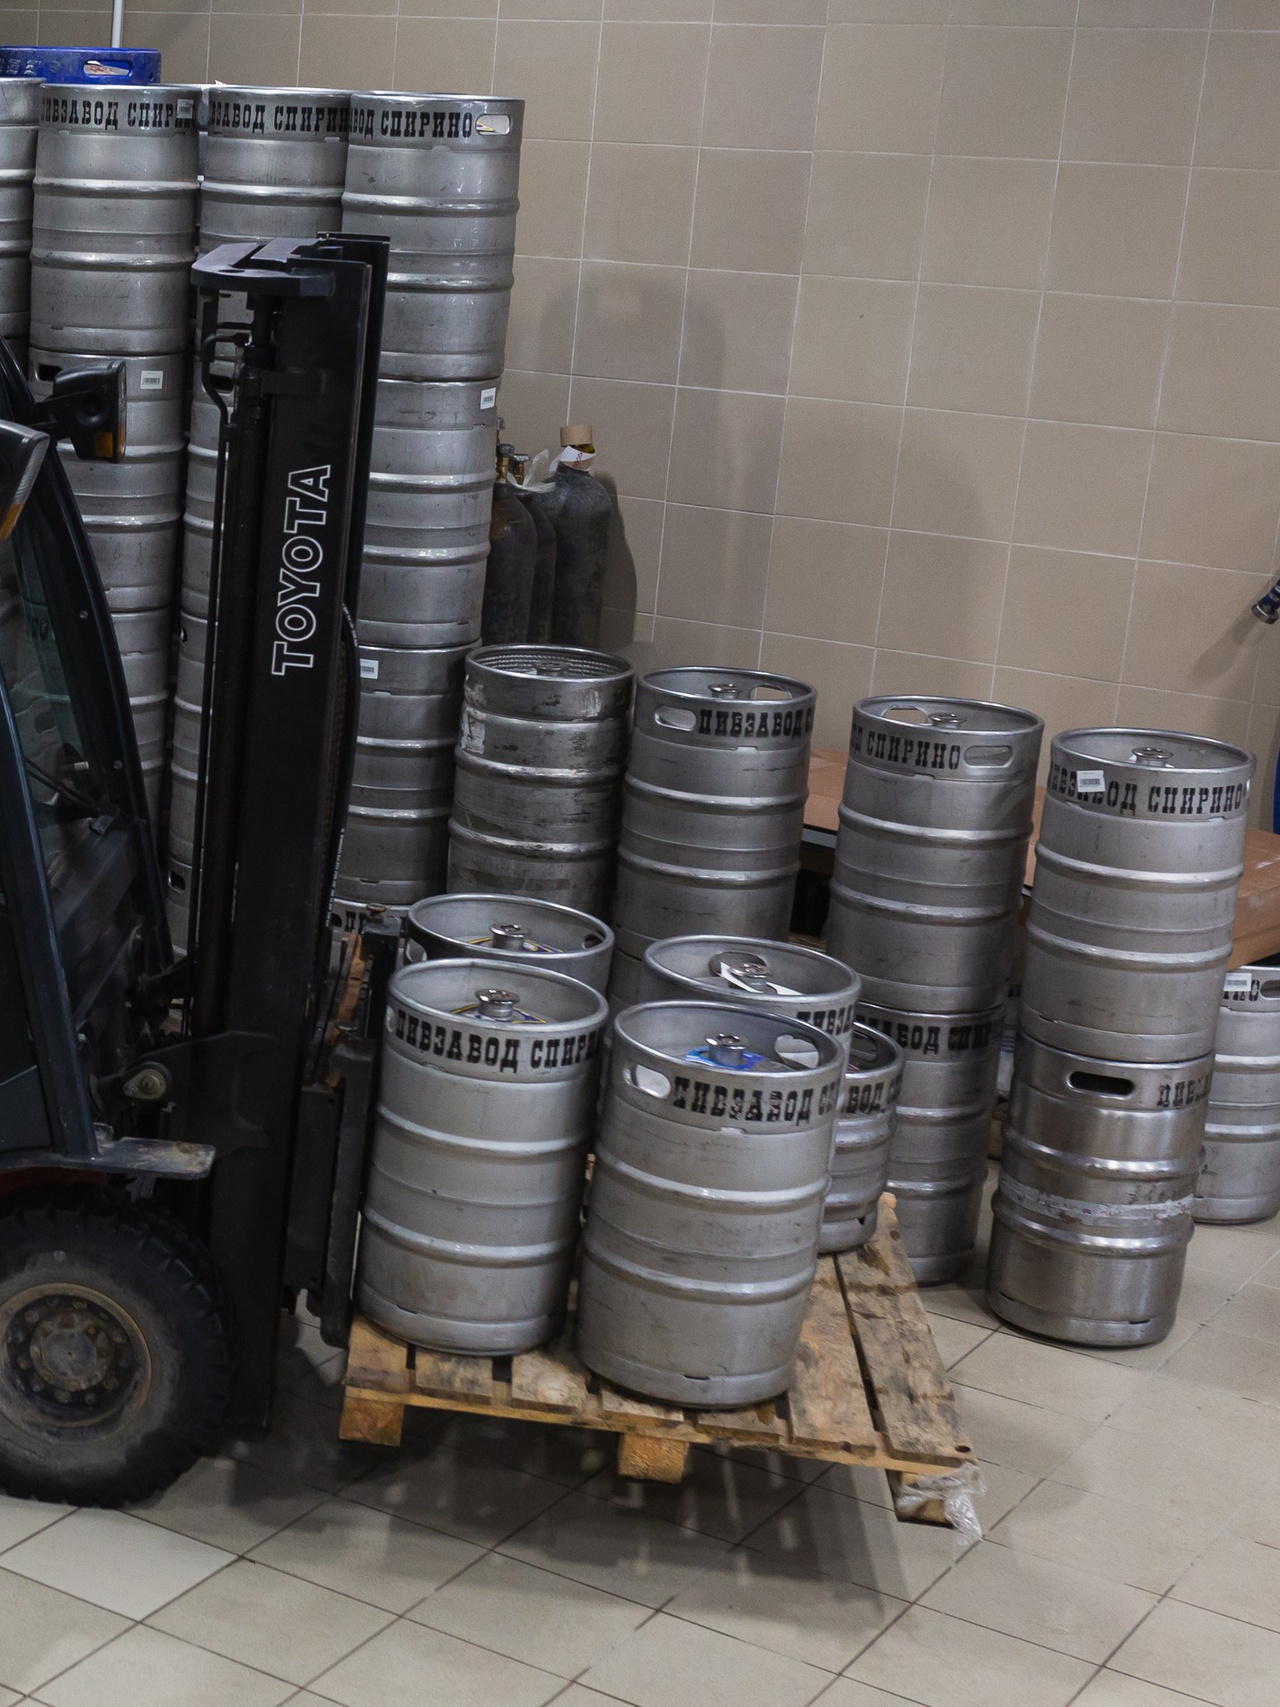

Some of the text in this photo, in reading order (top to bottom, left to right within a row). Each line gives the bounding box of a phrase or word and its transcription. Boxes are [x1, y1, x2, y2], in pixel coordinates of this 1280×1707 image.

[380, 110, 473, 138] СПИРИНО
[271, 464, 331, 676] TOYOTA
[698, 708, 804, 738] ПИВЗАВОД
[866, 730, 961, 770] СПИРИНО
[1147, 783, 1244, 815] СПИРИНО
[395, 1008, 519, 1074] ПИВЗАВОД
